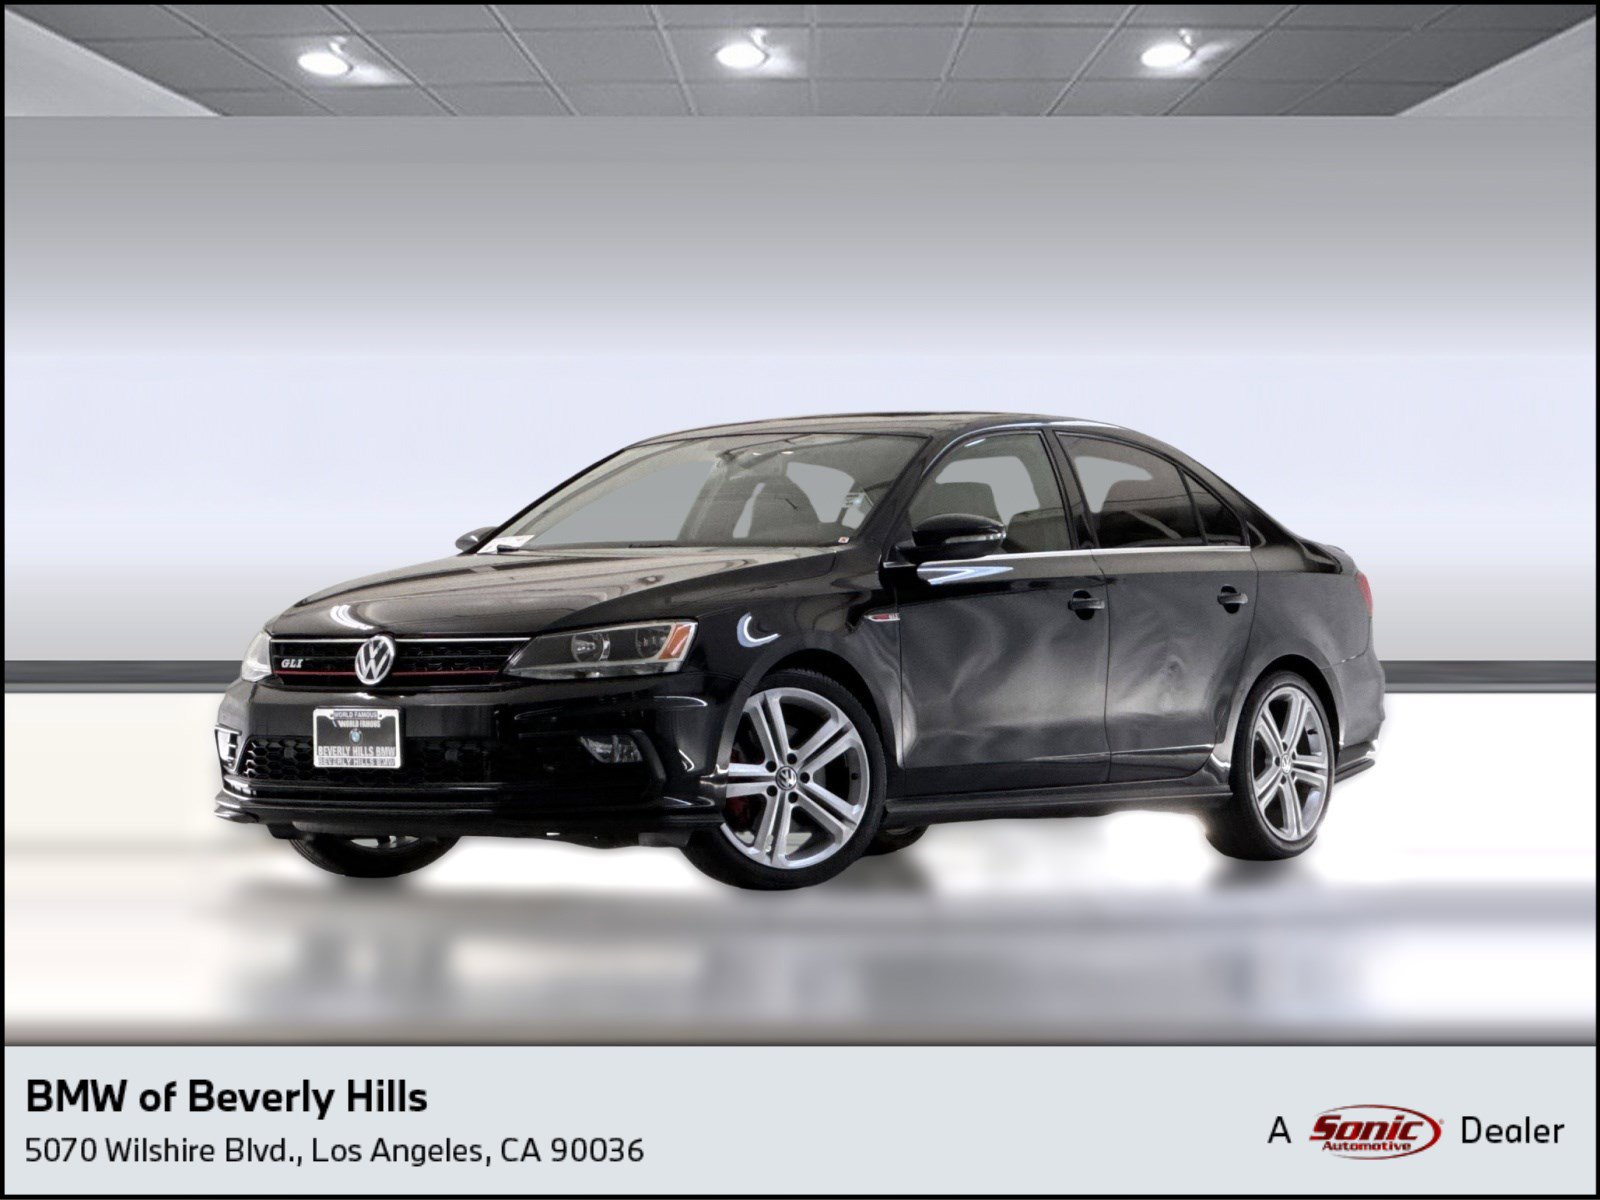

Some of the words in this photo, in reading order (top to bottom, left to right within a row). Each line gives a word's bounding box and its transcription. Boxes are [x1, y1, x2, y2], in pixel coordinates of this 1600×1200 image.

[280, 658, 304, 669] GLI
[333, 711, 353, 719] WORLD
[354, 711, 378, 719] FAMOUS
[338, 720, 359, 728] WORLD
[318, 746, 350, 756] BEVERLY
[352, 746, 374, 756] HILLS
[376, 746, 396, 756] BMW
